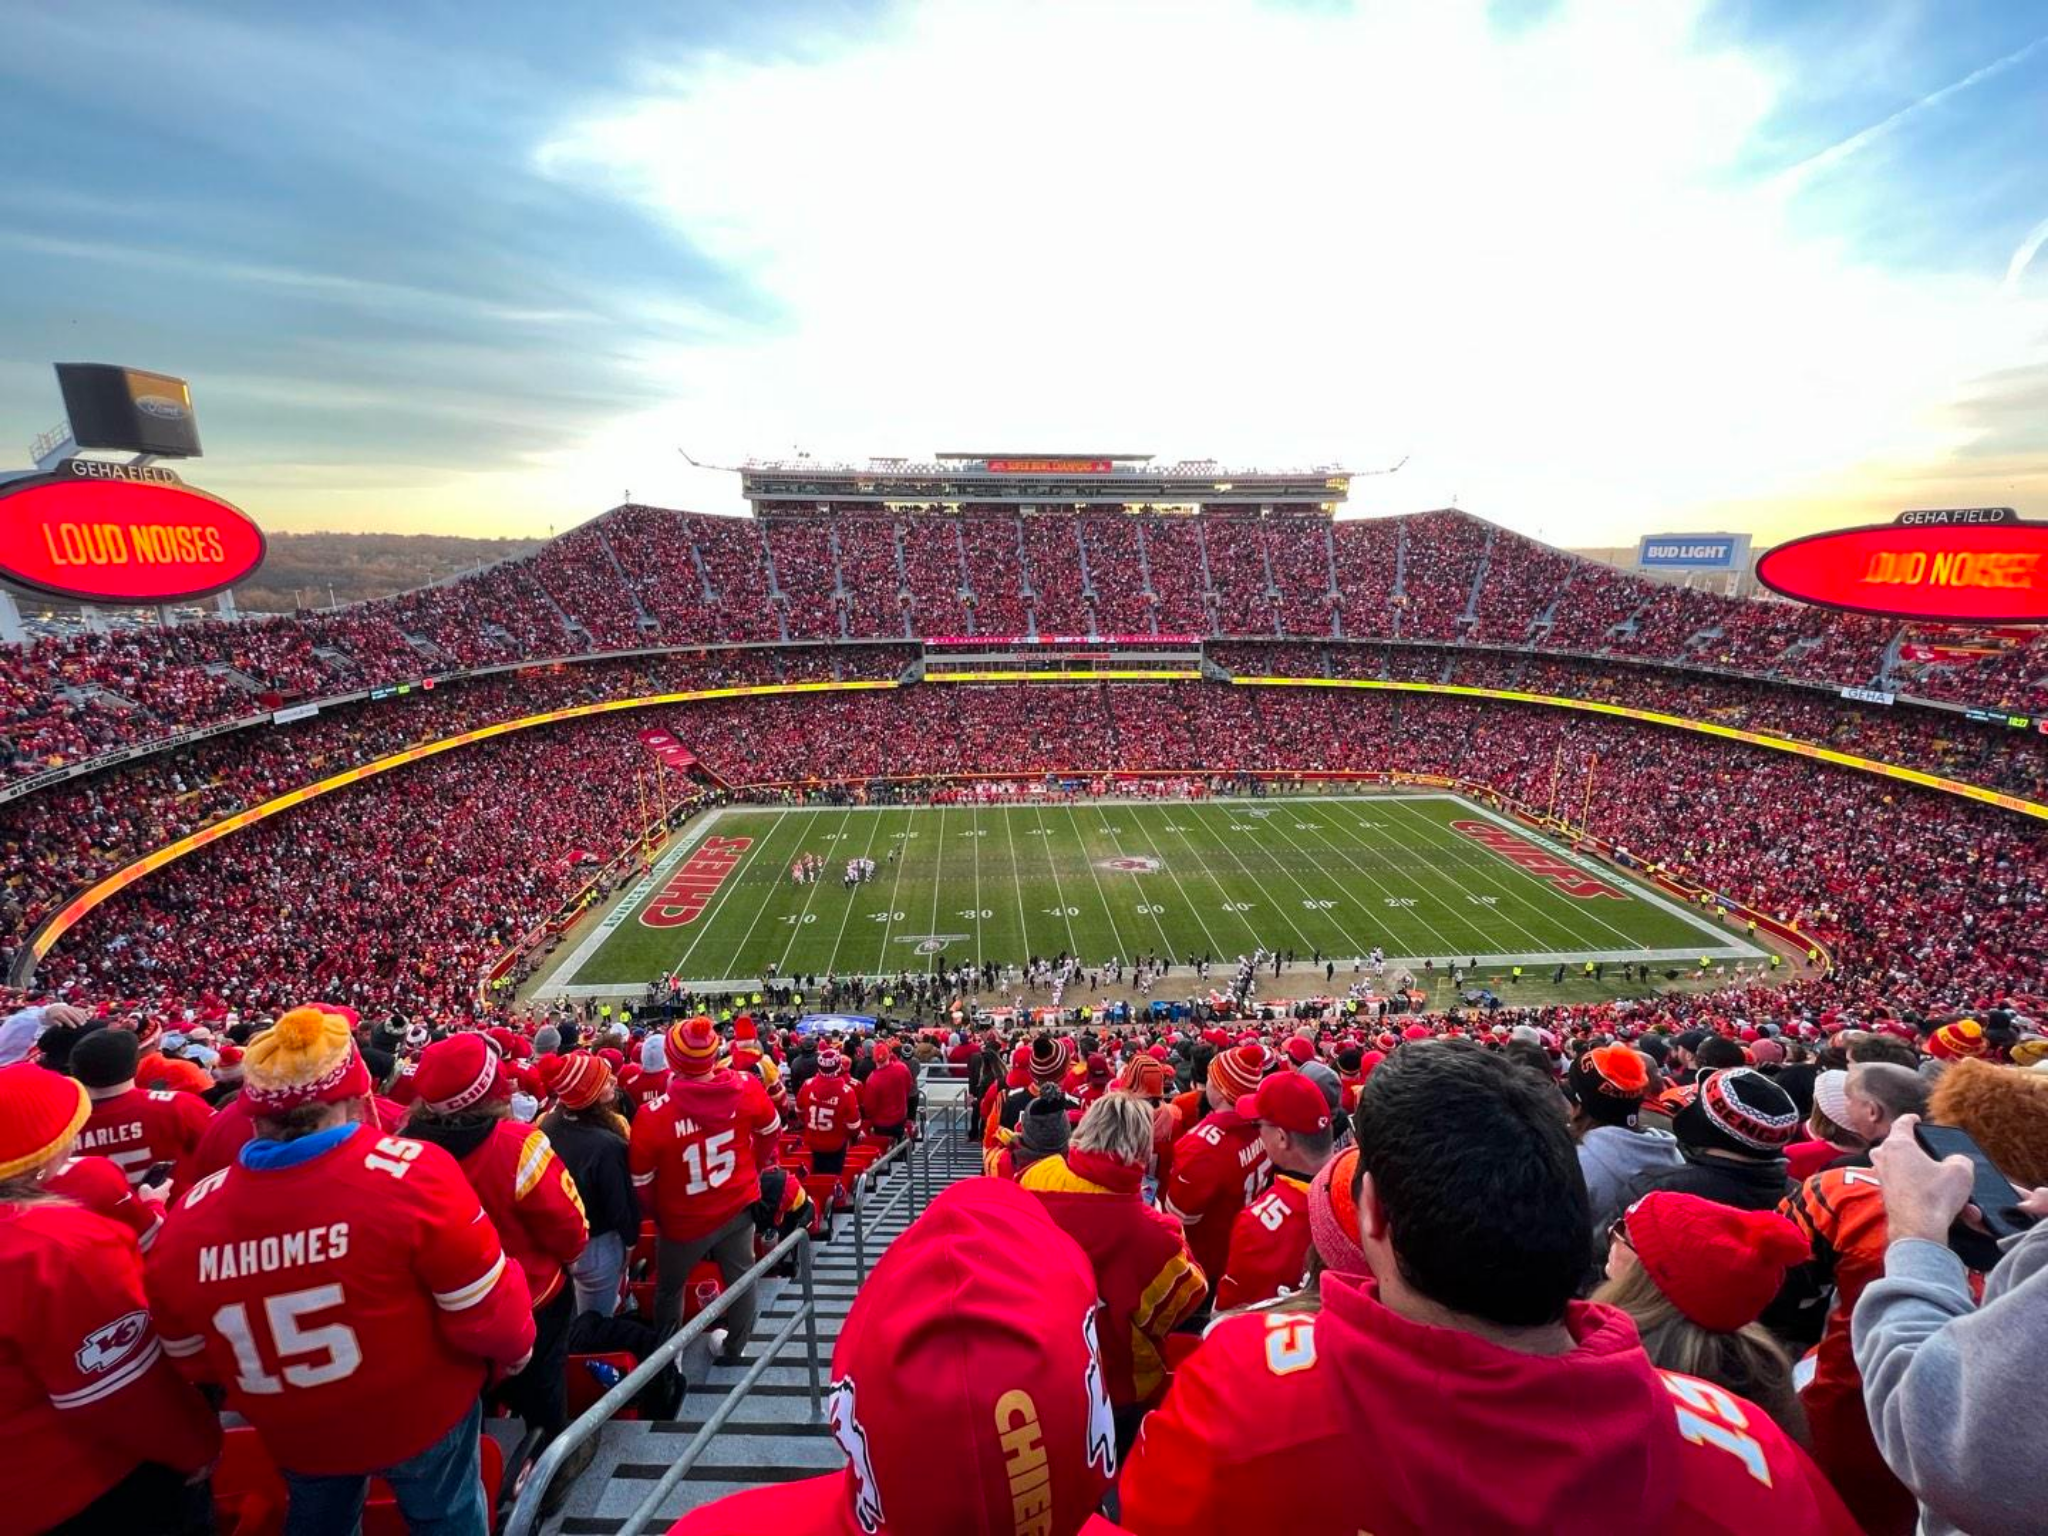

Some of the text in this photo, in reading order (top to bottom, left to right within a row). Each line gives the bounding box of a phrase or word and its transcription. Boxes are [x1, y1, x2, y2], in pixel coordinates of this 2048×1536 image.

[72, 460, 175, 484] GEHA FIELD
[1901, 508, 2005, 525] GEHA FIELD
[42, 522, 225, 566] LOUD NOISES
[1647, 545, 1728, 559] BUD LIGHT
[1848, 688, 1886, 703] GEHA
[1450, 820, 1635, 900] CHIEFS
[638, 835, 754, 929] CHIEFS
[785, 913, 817, 924] 10
[876, 911, 906, 922] 20
[963, 909, 994, 920] 30
[1050, 906, 1080, 917] 40
[1136, 904, 1165, 914] 50
[1221, 902, 1250, 912] 40
[446, 1055, 497, 1111] CHIEFS
[808, 1105, 835, 1132] 15
[73, 1121, 143, 1152] HARLES
[1198, 1124, 1226, 1146] 15
[364, 1137, 424, 1180] 15
[682, 1129, 736, 1196] 15
[184, 1166, 232, 1210] 5
[1250, 1194, 1292, 1231] 15
[199, 1222, 350, 1283] MAHOMES
[211, 1282, 363, 1395] 15
[995, 1389, 1052, 1536] CHIEF
